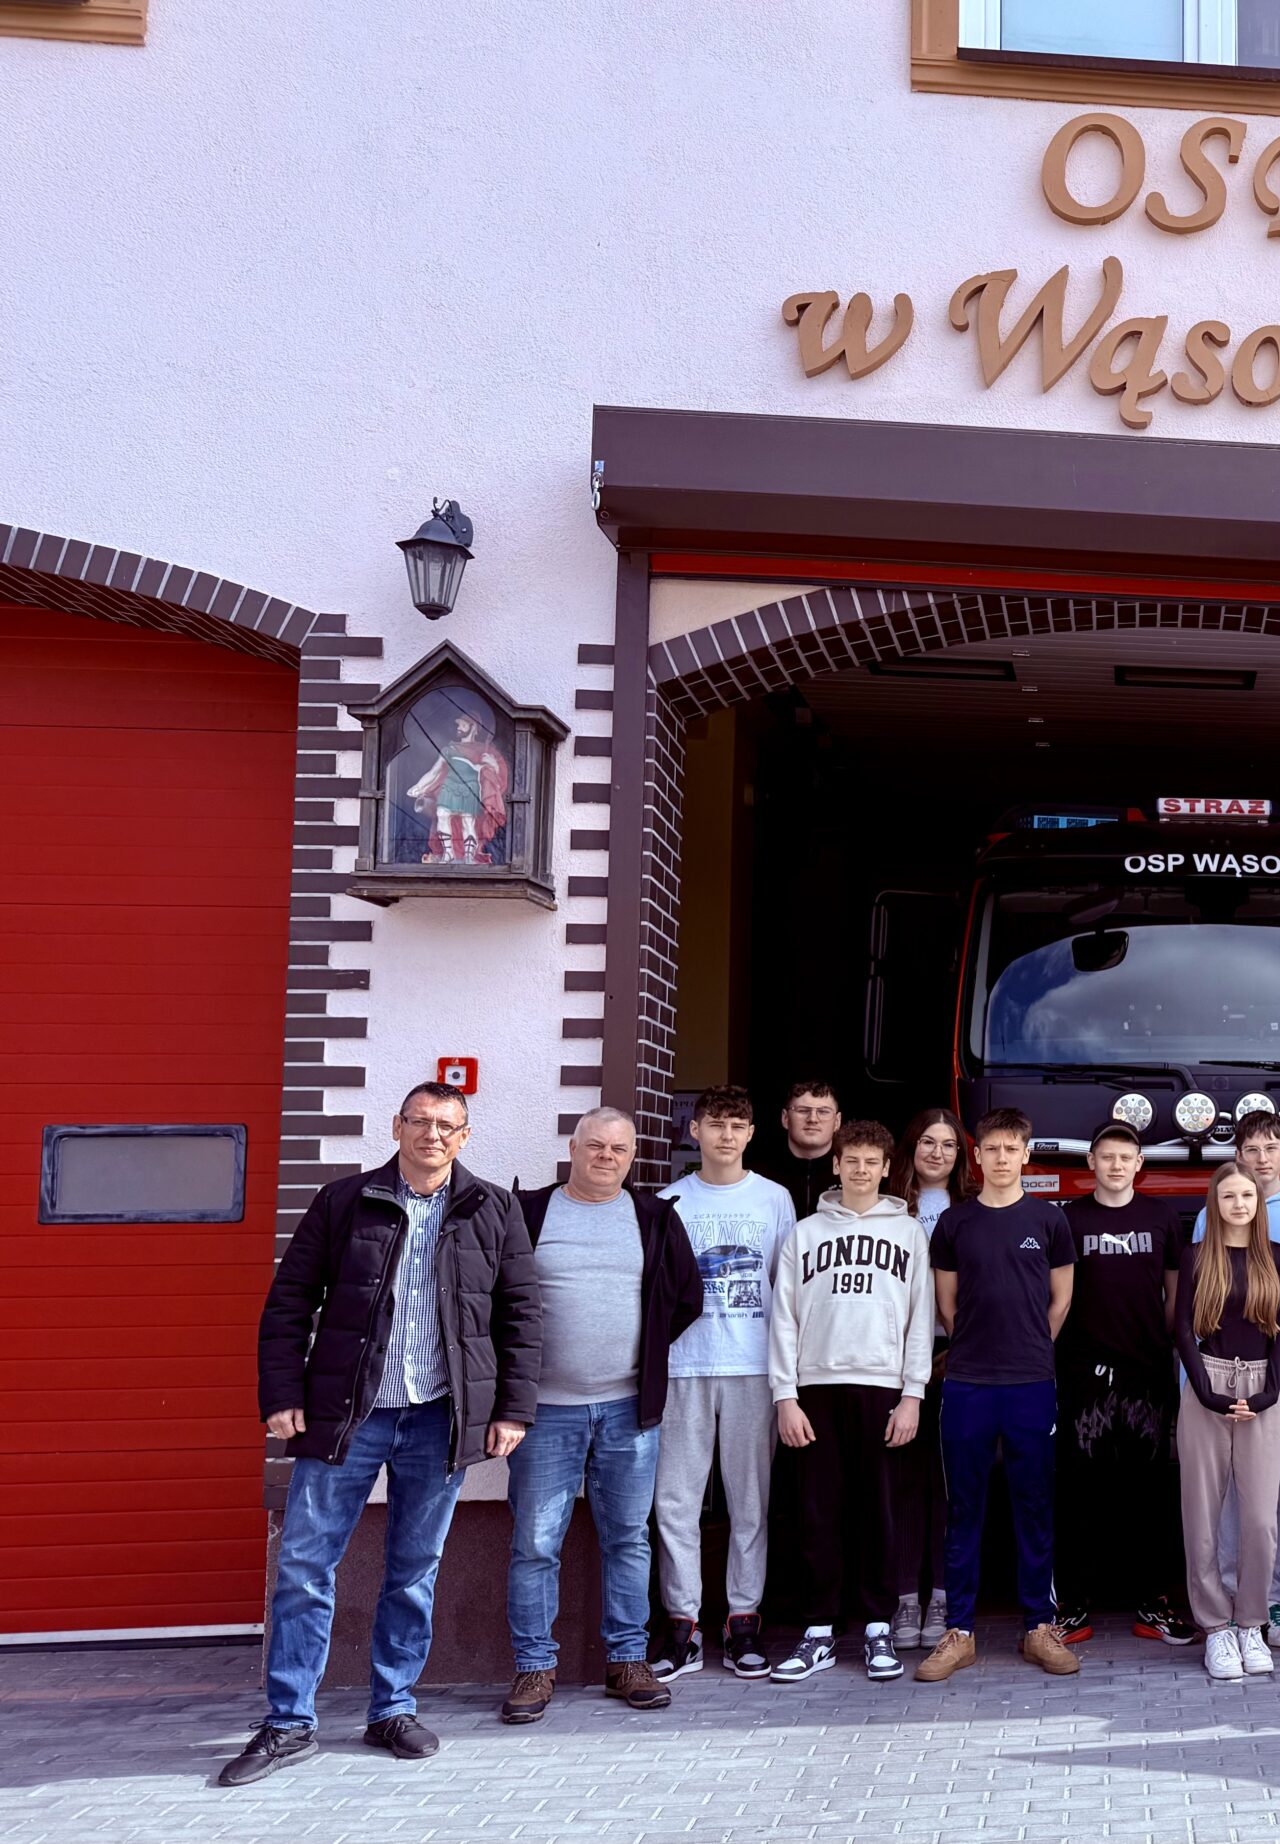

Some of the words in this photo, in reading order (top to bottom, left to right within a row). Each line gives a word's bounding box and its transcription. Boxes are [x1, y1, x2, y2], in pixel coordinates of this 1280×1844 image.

[782, 289, 913, 379] w
[1124, 854, 1185, 873] OSP
[1021, 1180, 1058, 1188] bocar
[1083, 1232, 1153, 1256] PUMA
[802, 1235, 910, 1285] LONDON
[832, 1272, 873, 1294] 1991
